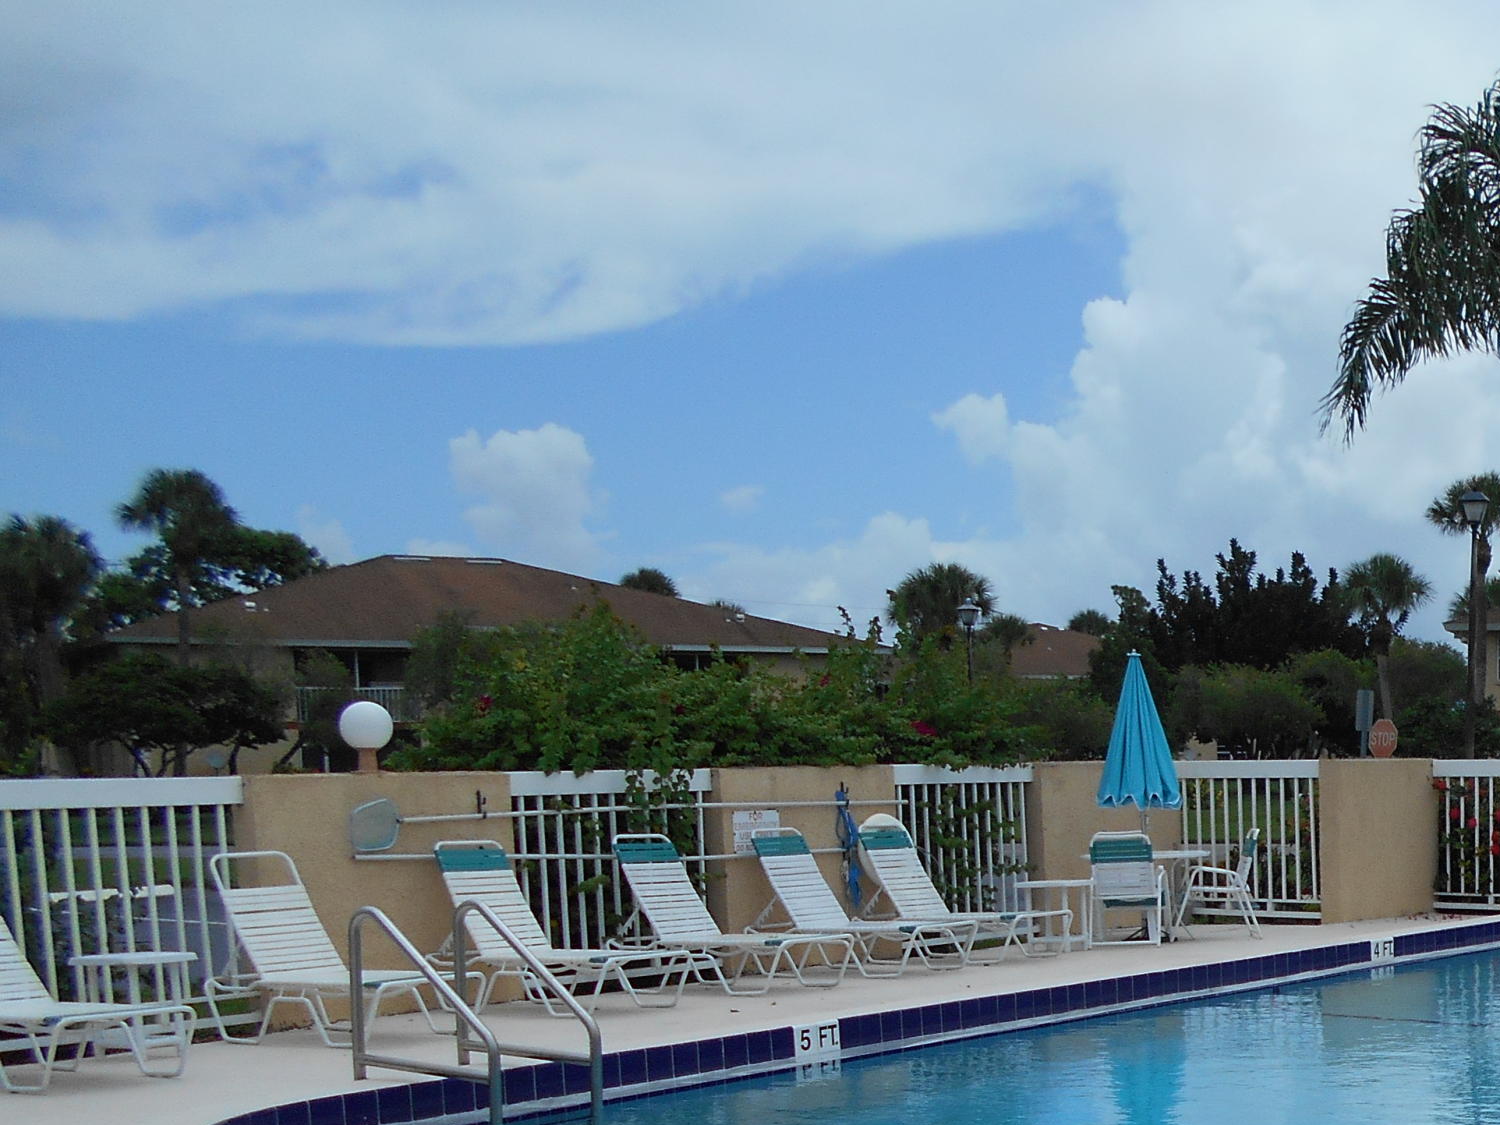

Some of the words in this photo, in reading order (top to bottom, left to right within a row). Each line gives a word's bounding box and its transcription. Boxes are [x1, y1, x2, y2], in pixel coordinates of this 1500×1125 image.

[1371, 732, 1396, 746] STOP
[749, 812, 764, 821] FOR
[1374, 942, 1380, 958] 4
[800, 1029, 811, 1051] 5
[819, 1024, 839, 1049] FT.
